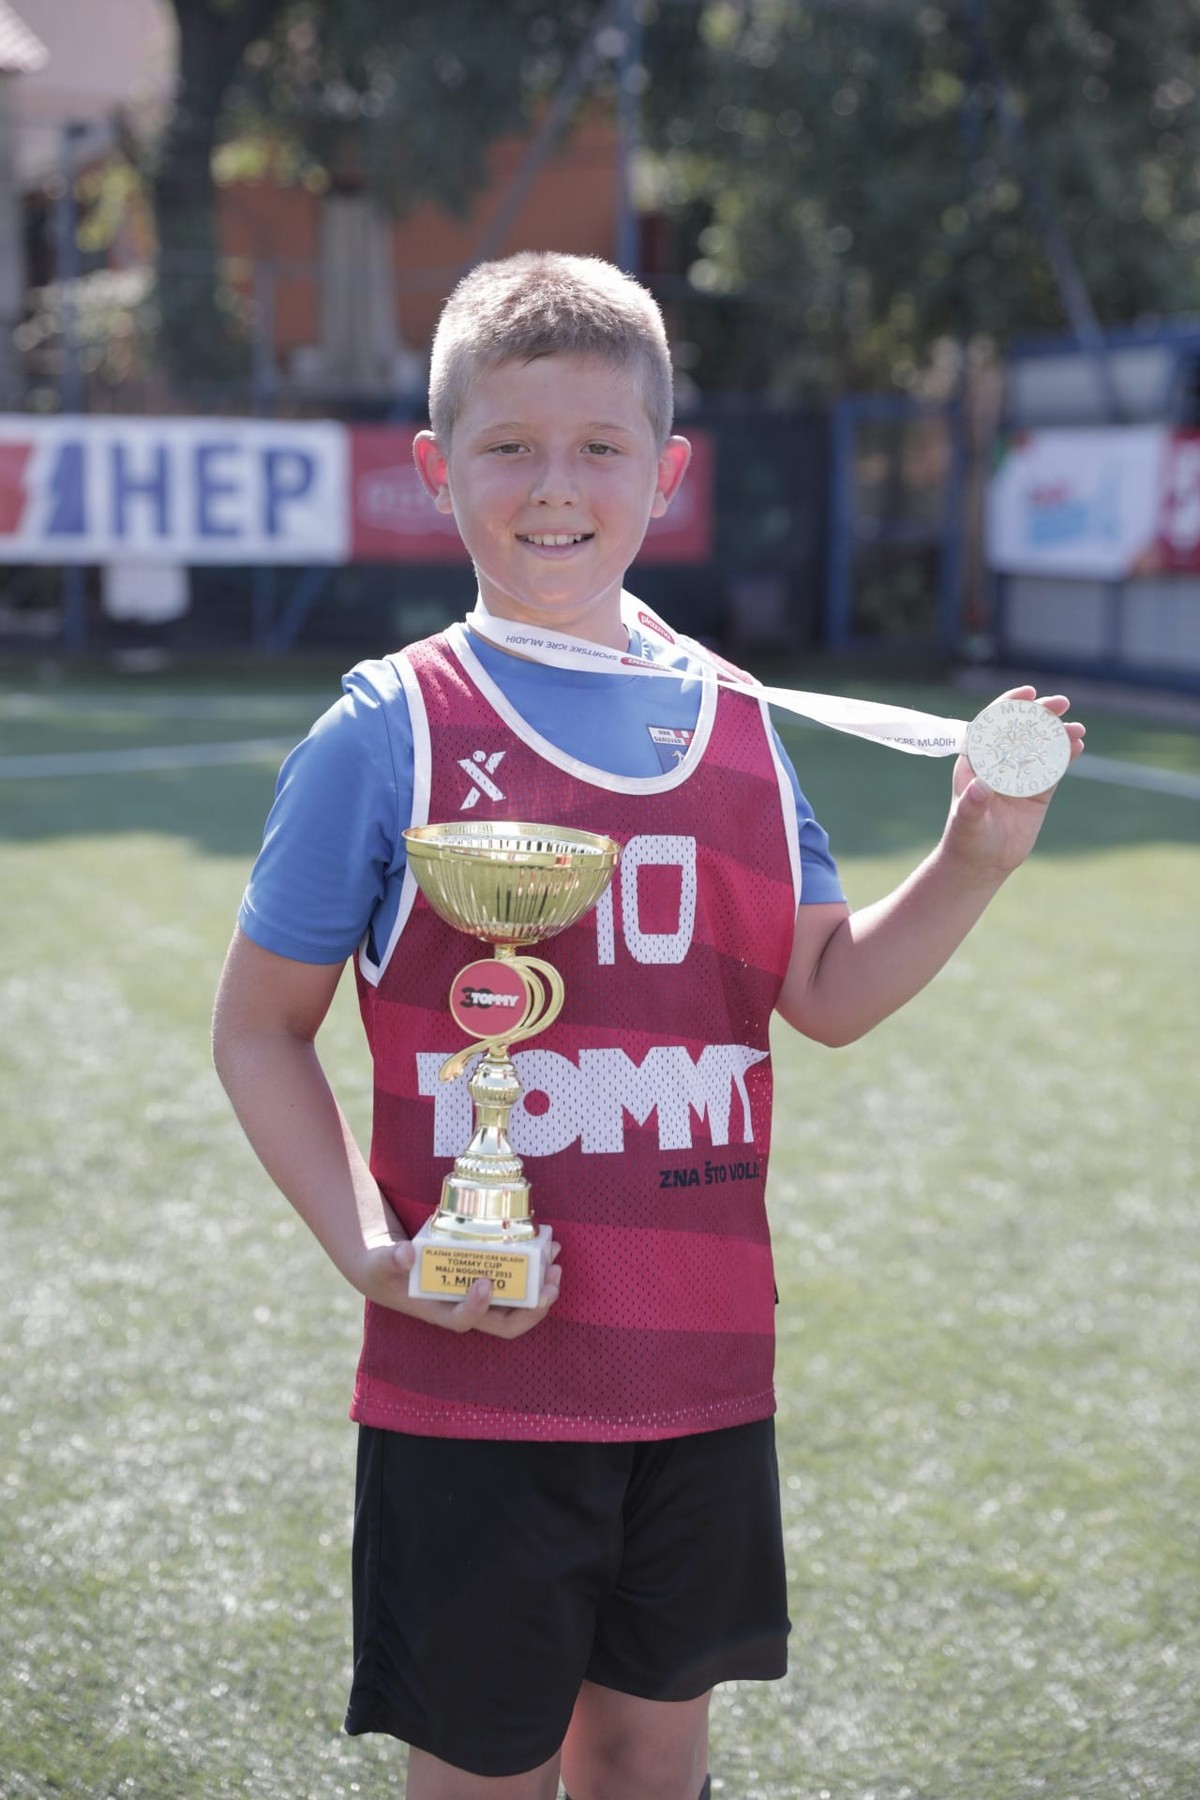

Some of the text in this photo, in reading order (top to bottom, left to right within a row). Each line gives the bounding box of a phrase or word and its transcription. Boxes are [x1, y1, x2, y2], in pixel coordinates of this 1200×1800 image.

[113, 440, 316, 538] HEP
[505, 635, 618, 661] SPORTSKE IGRE MLADIH
[918, 738, 957, 747] MLADIH
[595, 834, 697, 966] 10
[470, 992, 521, 1008] TOMMY
[415, 1044, 770, 1158] TOMMY
[659, 1168, 701, 1189] ZNA
[704, 1160, 727, 1185] ŠTO
[435, 1266, 454, 1274] MALI
[456, 1268, 493, 1277] NOGOMET
[448, 1258, 502, 1269] TOMMY CUP
[440, 1275, 451, 1285] 1.
